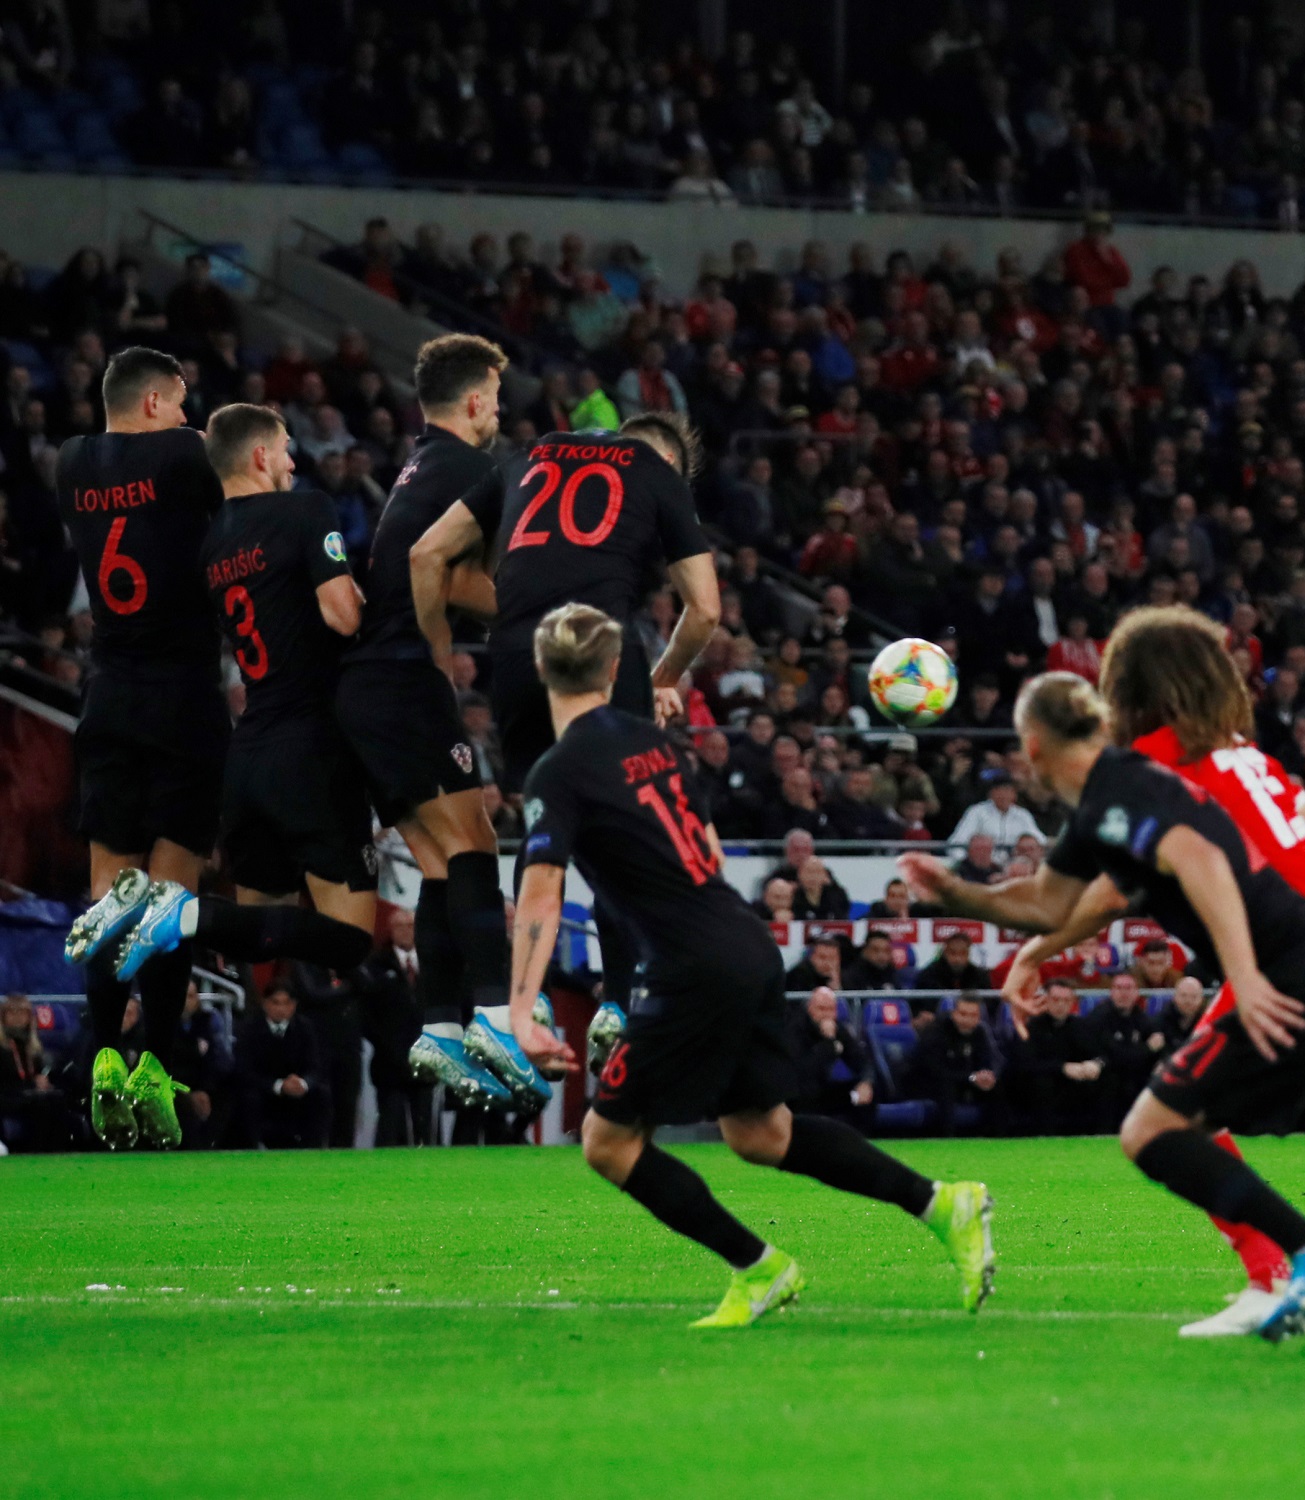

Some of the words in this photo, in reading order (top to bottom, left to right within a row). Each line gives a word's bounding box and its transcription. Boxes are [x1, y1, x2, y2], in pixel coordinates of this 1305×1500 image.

[75, 478, 156, 511] LOVREN
[528, 443, 633, 466] PETKOVIĆ
[508, 461, 624, 551] 20
[98, 516, 147, 615] 6
[225, 585, 268, 679] 3
[637, 773, 717, 886] 16
